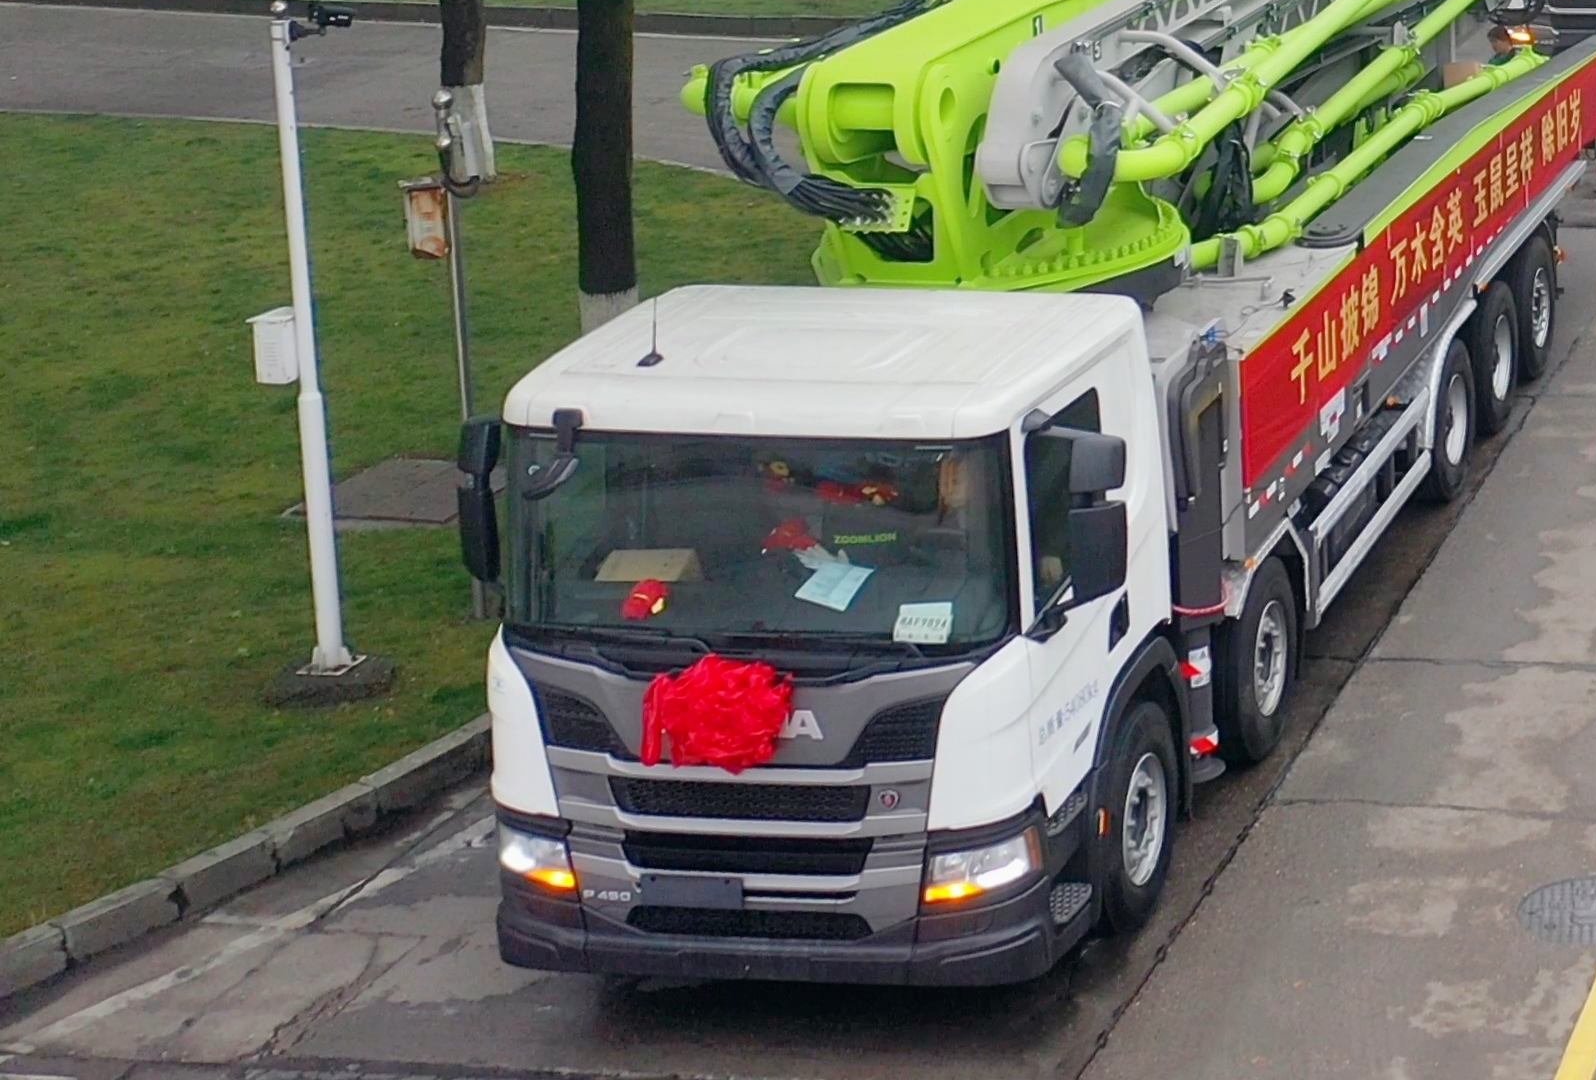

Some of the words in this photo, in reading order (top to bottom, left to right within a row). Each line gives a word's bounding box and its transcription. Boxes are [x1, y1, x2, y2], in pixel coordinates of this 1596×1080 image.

[1094, 41, 1101, 60] 5
[1290, 265, 1380, 405] 千山披锦
[1390, 191, 1464, 305] 万木含英
[1472, 129, 1534, 228] 玉鼠呈祥
[1541, 89, 1582, 165] 除旧岁
[834, 532, 897, 545] ZOOMLION
[583, 890, 595, 899] P
